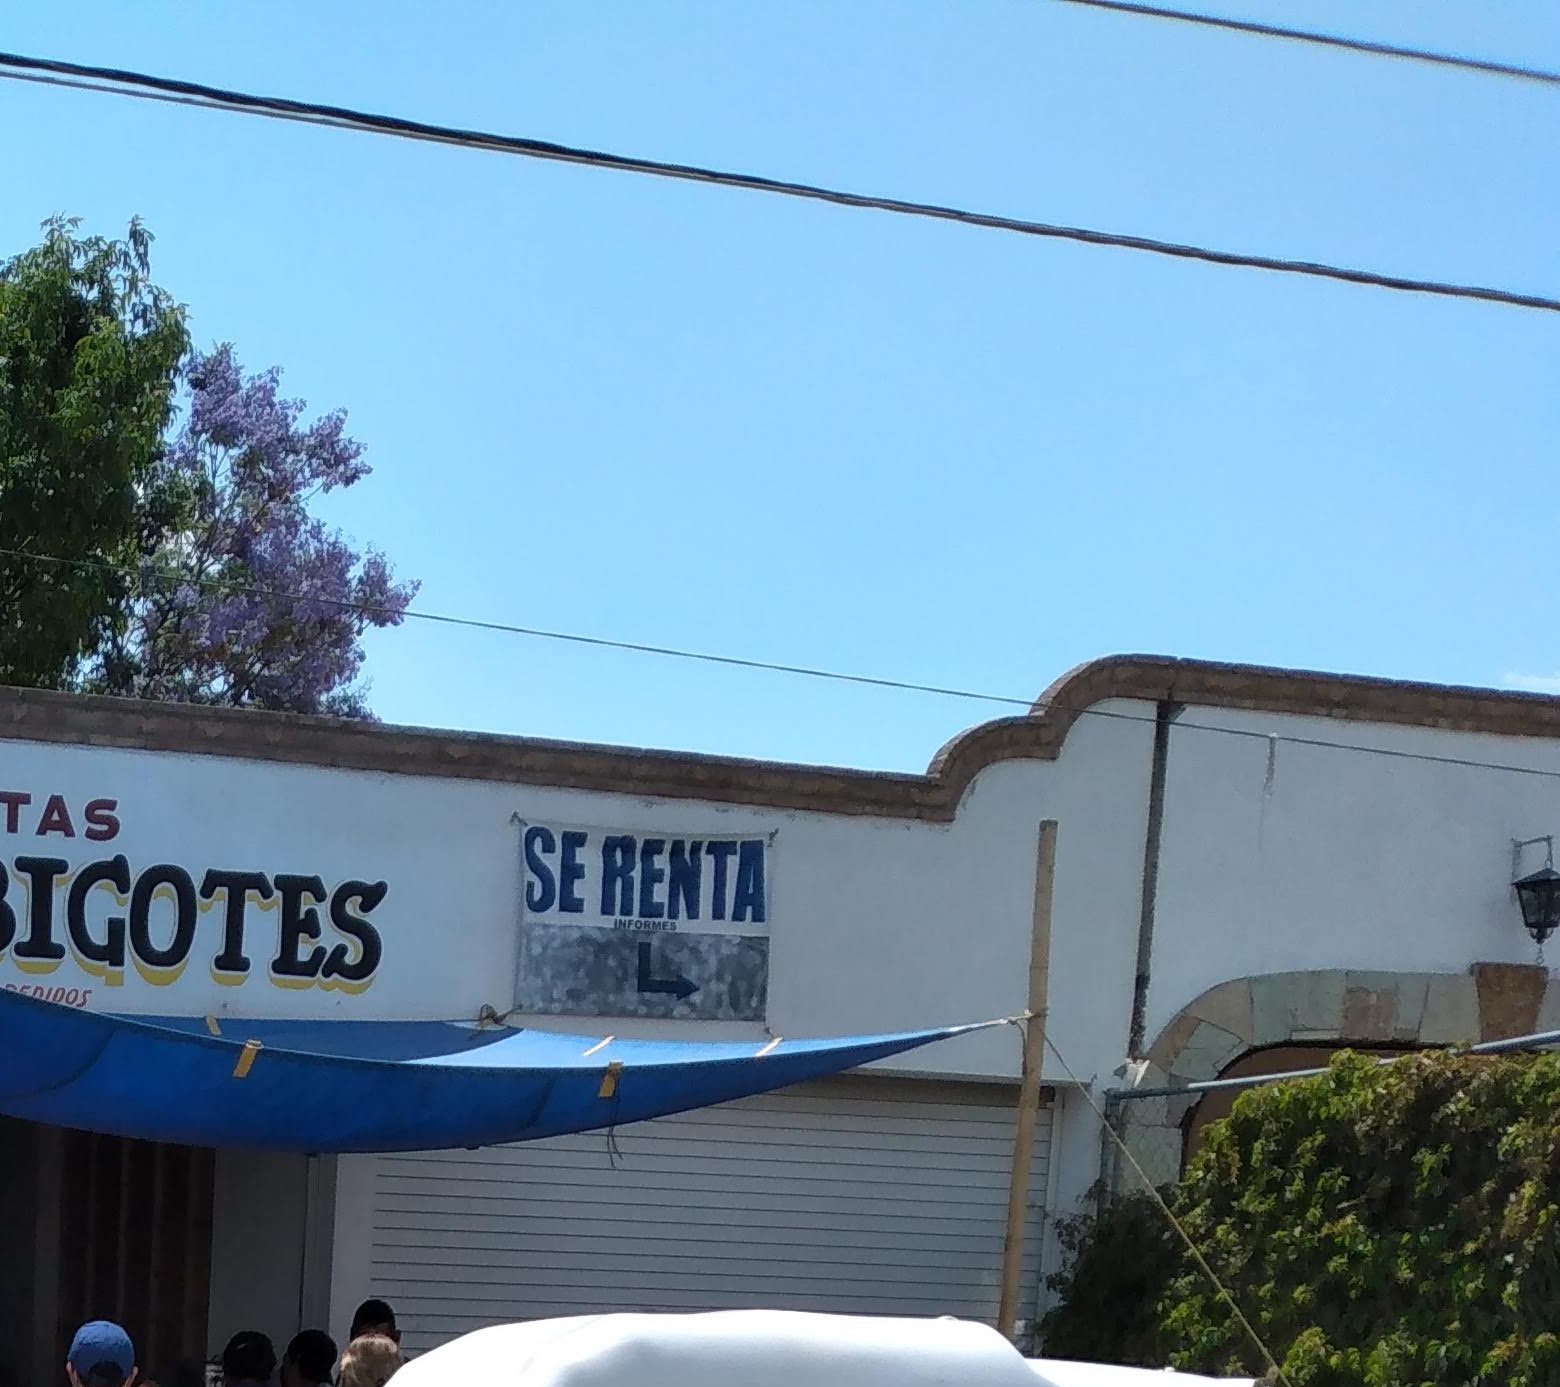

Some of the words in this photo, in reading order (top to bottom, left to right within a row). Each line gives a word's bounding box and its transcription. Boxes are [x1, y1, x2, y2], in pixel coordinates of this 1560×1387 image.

[524, 826, 588, 913] SE
[601, 835, 766, 922] RENTA
[614, 918, 677, 931] INFORMES
